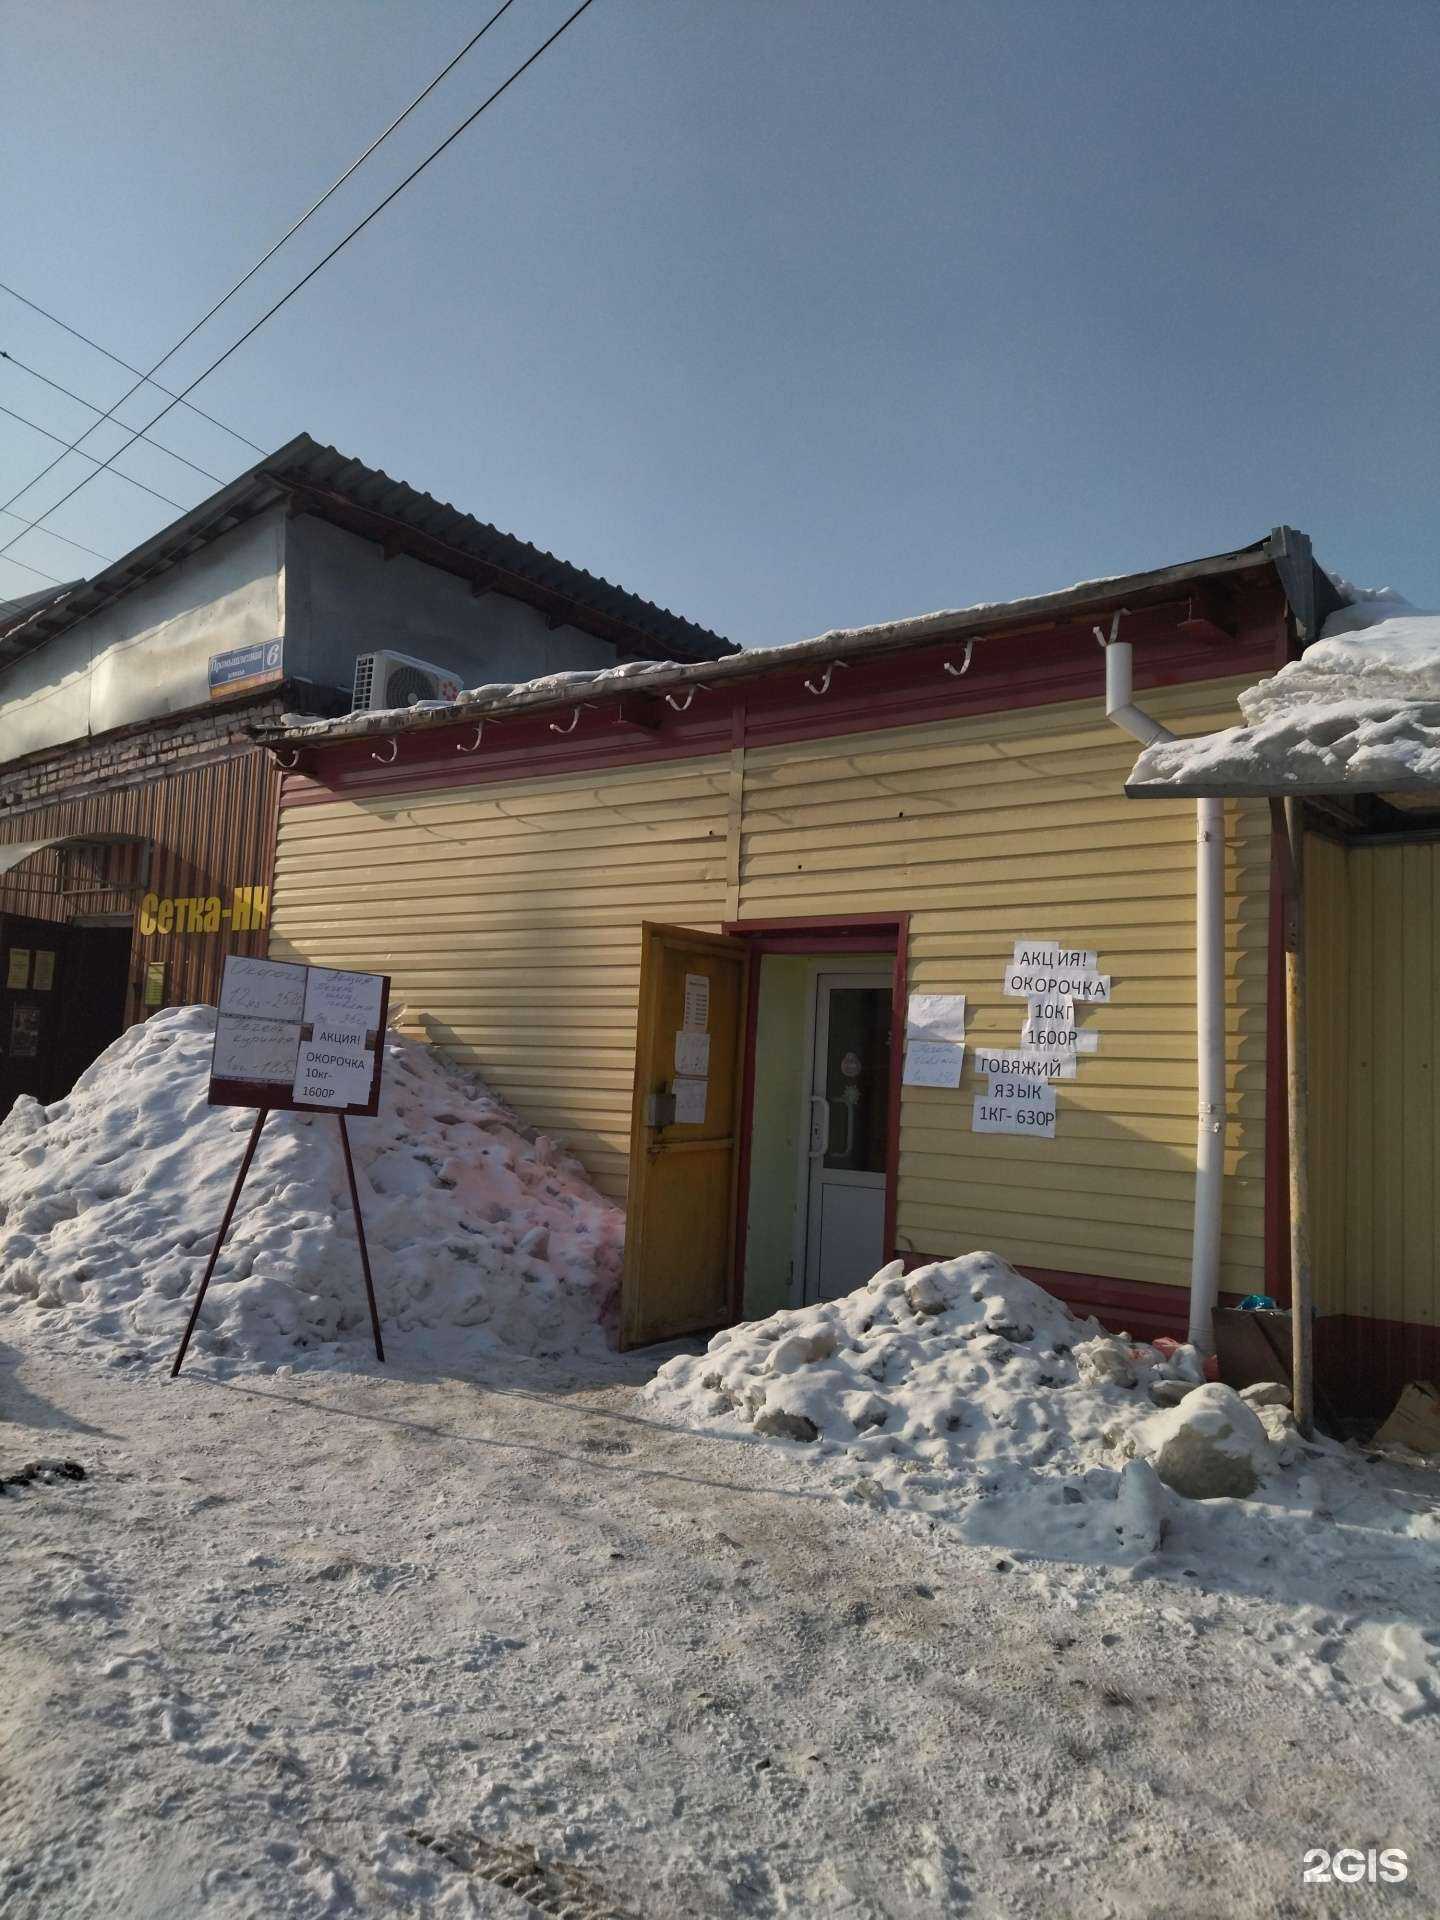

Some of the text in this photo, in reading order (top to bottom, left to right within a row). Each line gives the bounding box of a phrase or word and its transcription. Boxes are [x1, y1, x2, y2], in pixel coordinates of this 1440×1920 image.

[266, 643, 281, 666] 6
[1019, 950, 1087, 970] АКЦИЯ!
[1011, 975, 1107, 996] ОКОРОЧКА
[1034, 1004, 1074, 1020] 10КГ
[319, 1031, 361, 1047] АКЦИЯ!
[1028, 1030, 1078, 1046] 1600Р
[306, 1051, 365, 1070] ОКОРОЧКА
[981, 1057, 1061, 1077] ГОВЯЖИЙ
[303, 1086, 336, 1099] 1600Р
[994, 1083, 1042, 1100] ЯЗЫК
[1016, 1109, 1055, 1127] 630Р
